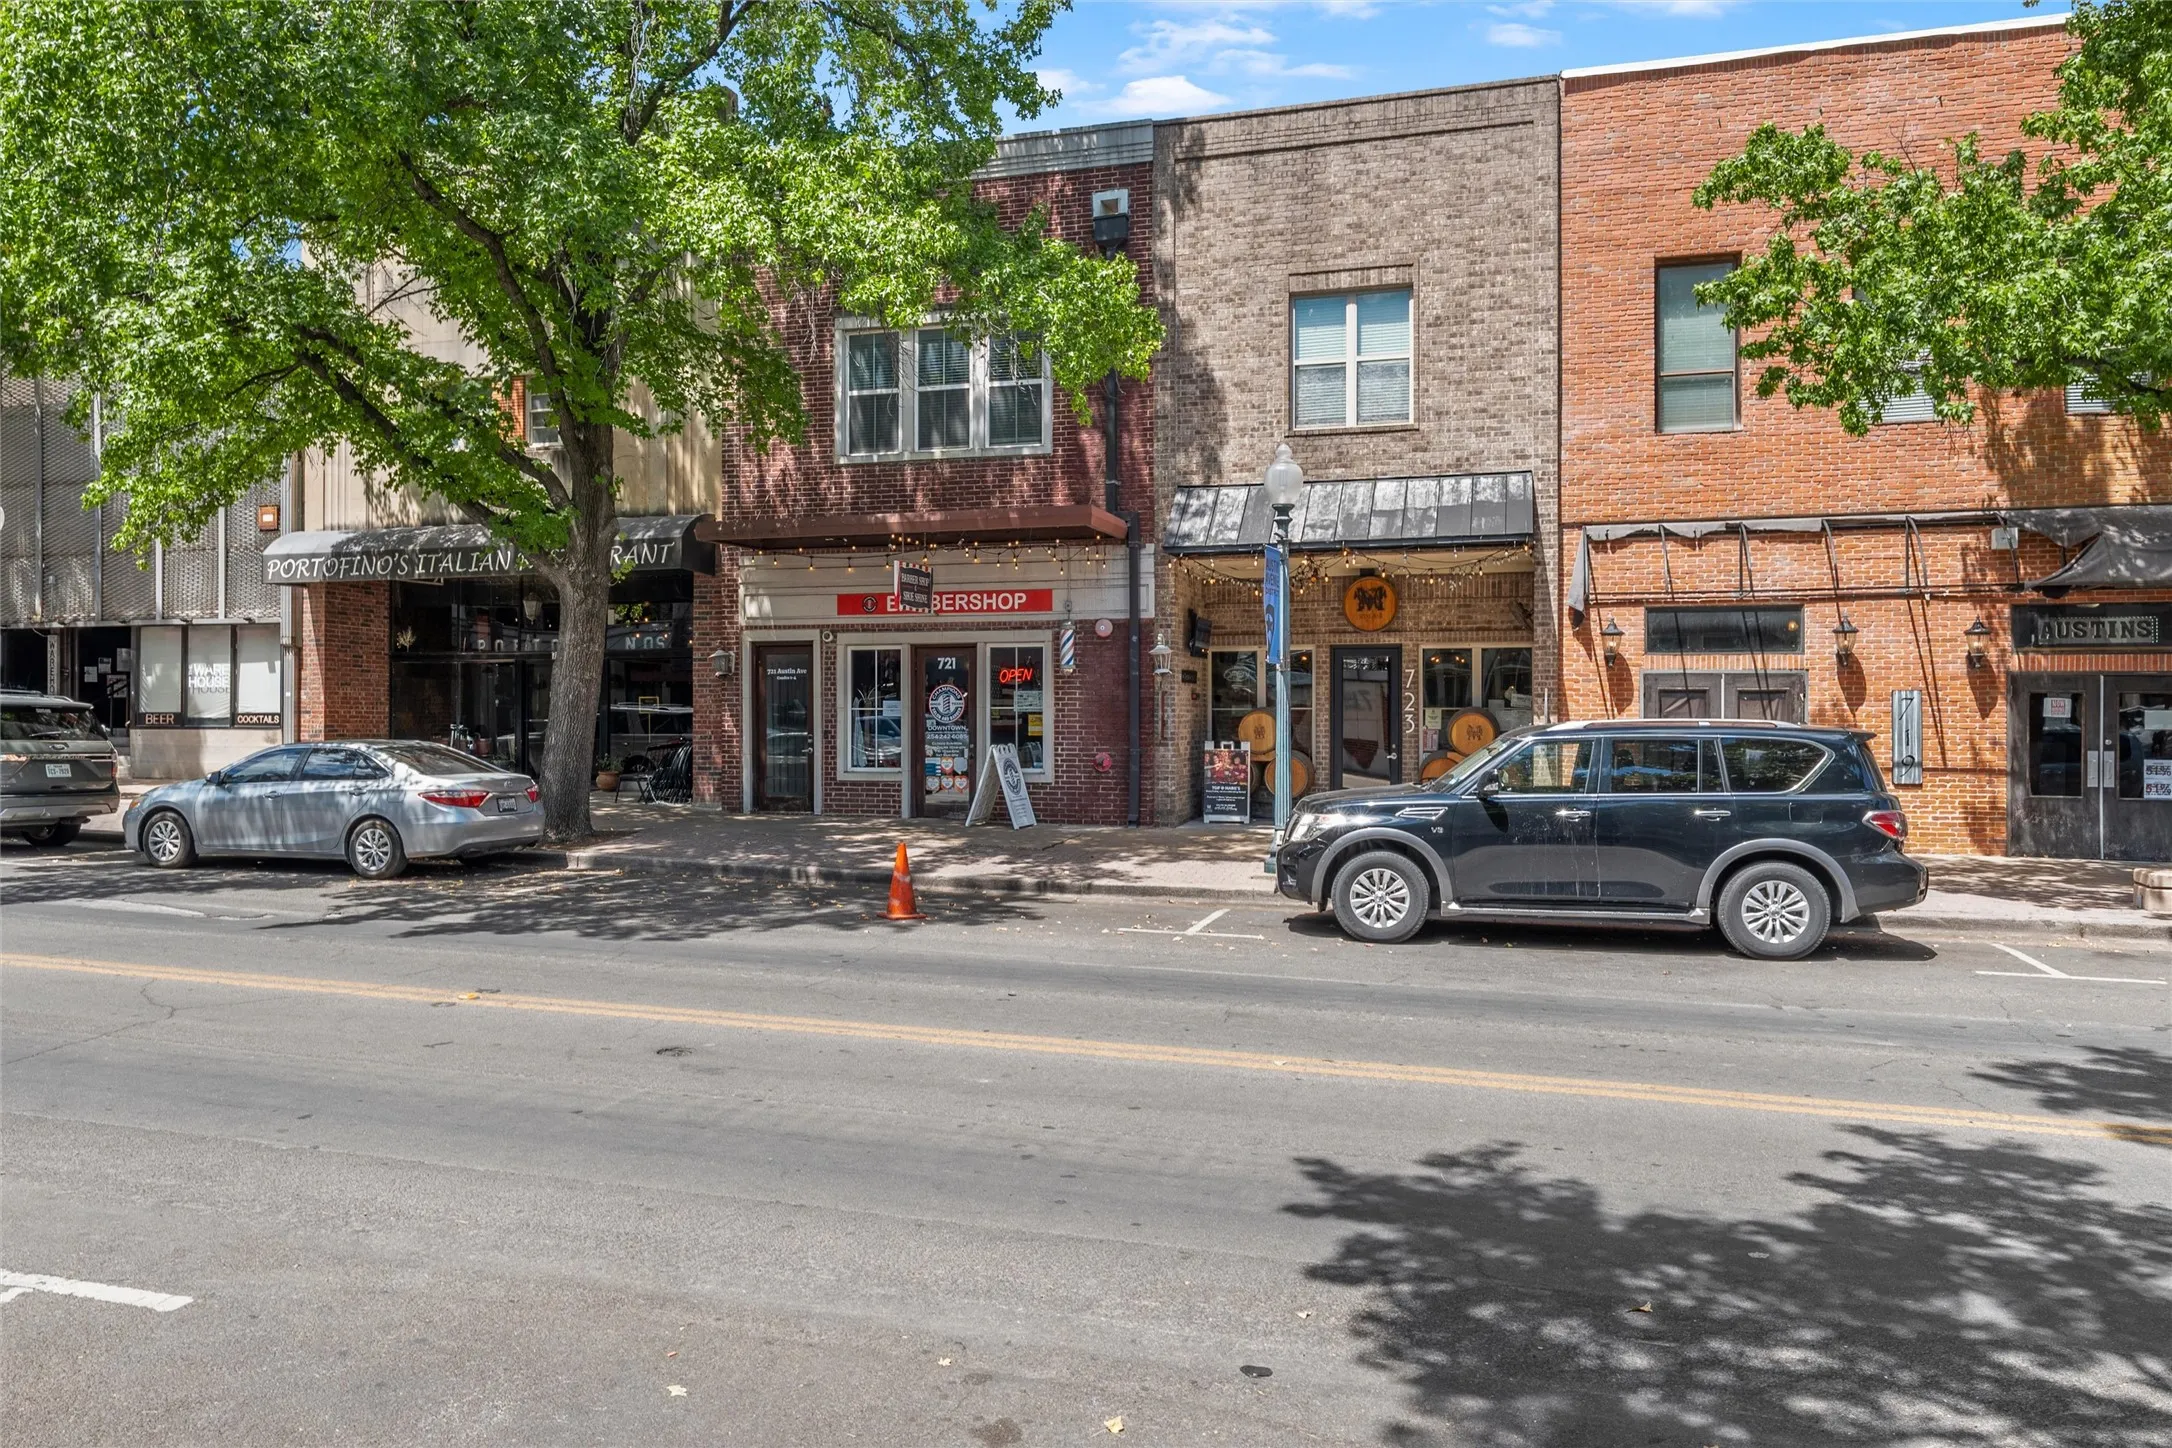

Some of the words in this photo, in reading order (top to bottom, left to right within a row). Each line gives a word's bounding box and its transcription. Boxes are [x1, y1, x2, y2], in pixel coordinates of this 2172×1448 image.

[267, 552, 409, 580] PORTOFINO'S
[415, 550, 511, 575] ITALIAN
[886, 592, 1027, 612] BERSHOP
[2040, 620, 2152, 639] AUSTINS
[48, 640, 56, 694] WAREHO
[193, 663, 230, 677] WARE
[937, 657, 956, 669] 721
[188, 676, 230, 689] HOUSE
[1000, 667, 1033, 683] OPEN
[932, 686, 961, 700] CHAMPIONS
[1404, 669, 1416, 734] 723
[145, 713, 175, 725] BEER
[237, 715, 280, 724] COCKTAILS
